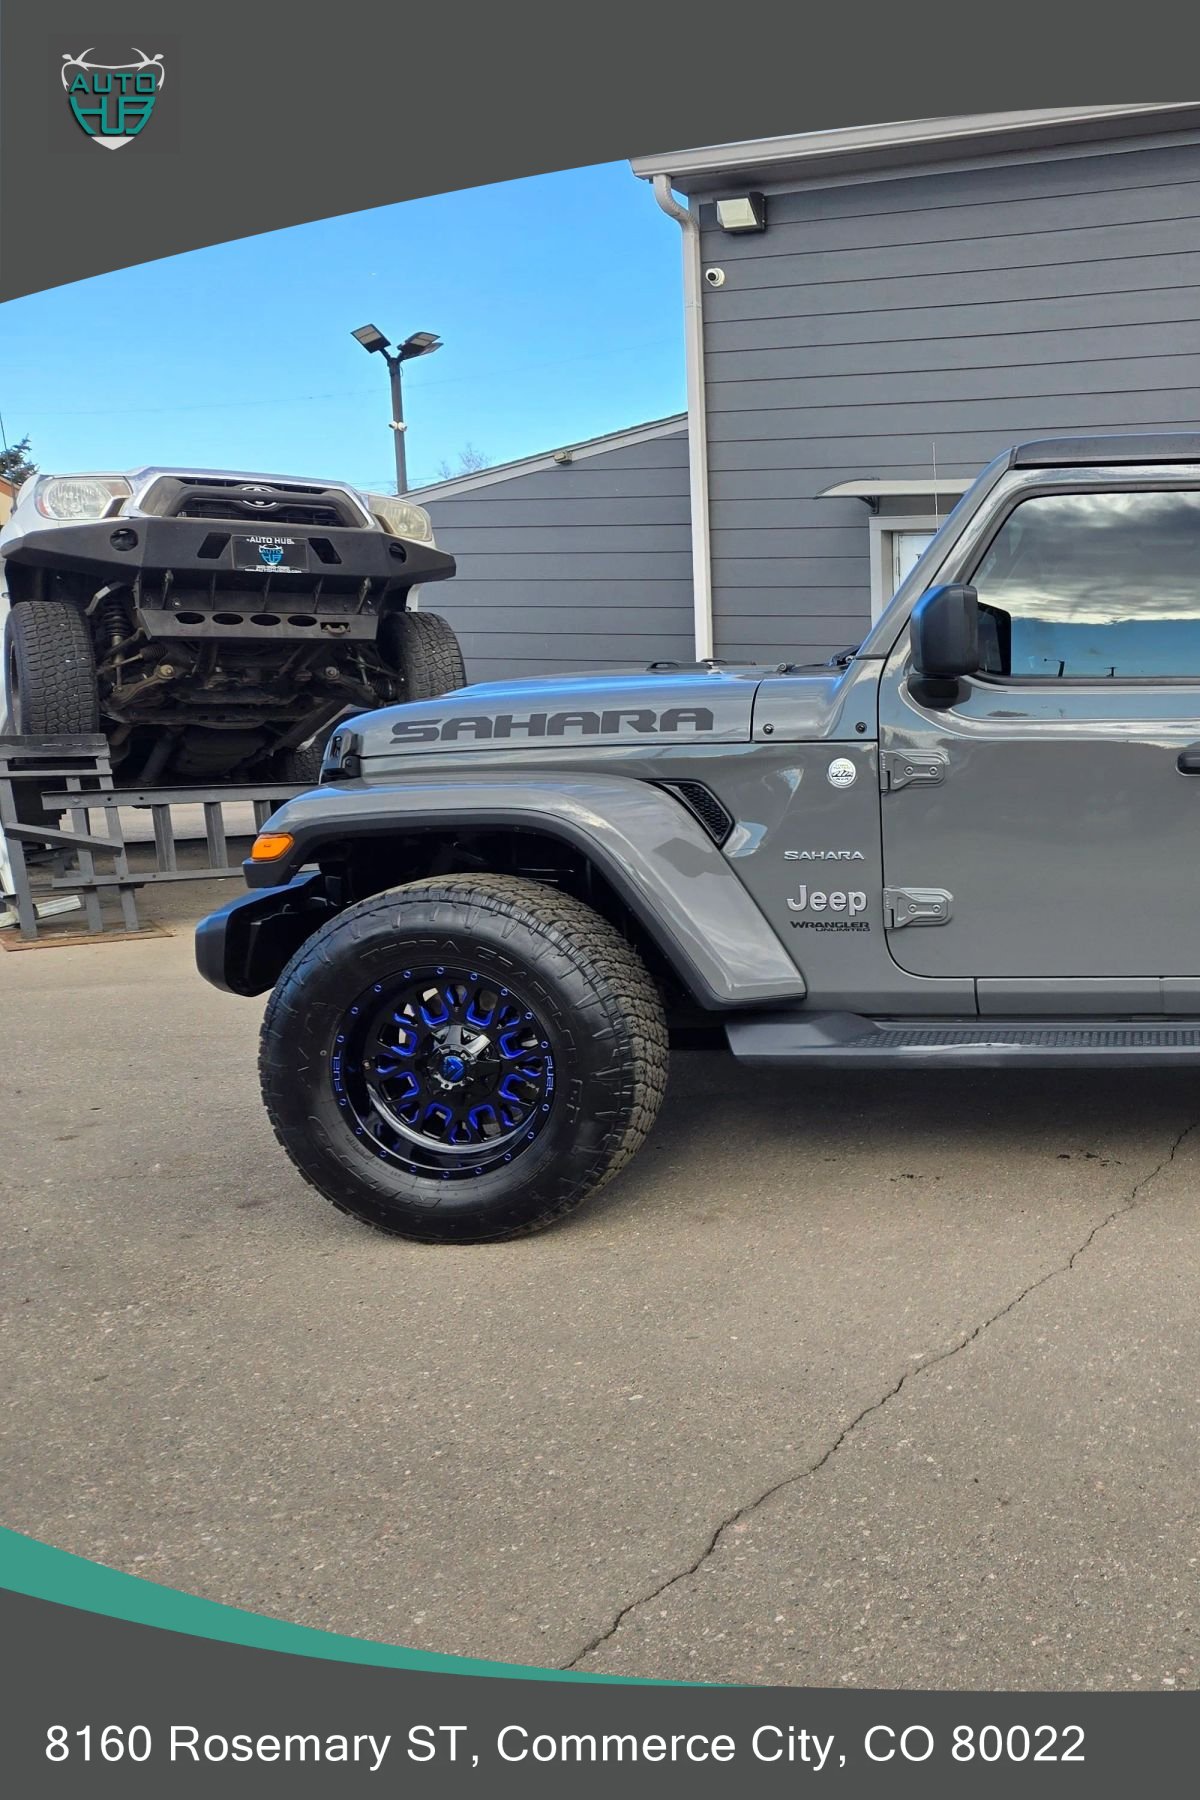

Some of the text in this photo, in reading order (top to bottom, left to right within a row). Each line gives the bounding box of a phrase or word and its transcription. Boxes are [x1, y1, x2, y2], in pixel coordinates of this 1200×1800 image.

[249, 536, 292, 545] AUTO HUB
[390, 707, 714, 744] SAHARA
[784, 851, 865, 861] SAHARA
[786, 884, 867, 916] Jeep
[790, 921, 870, 929] WRANGLER
[544, 1056, 554, 1097] FUEL
